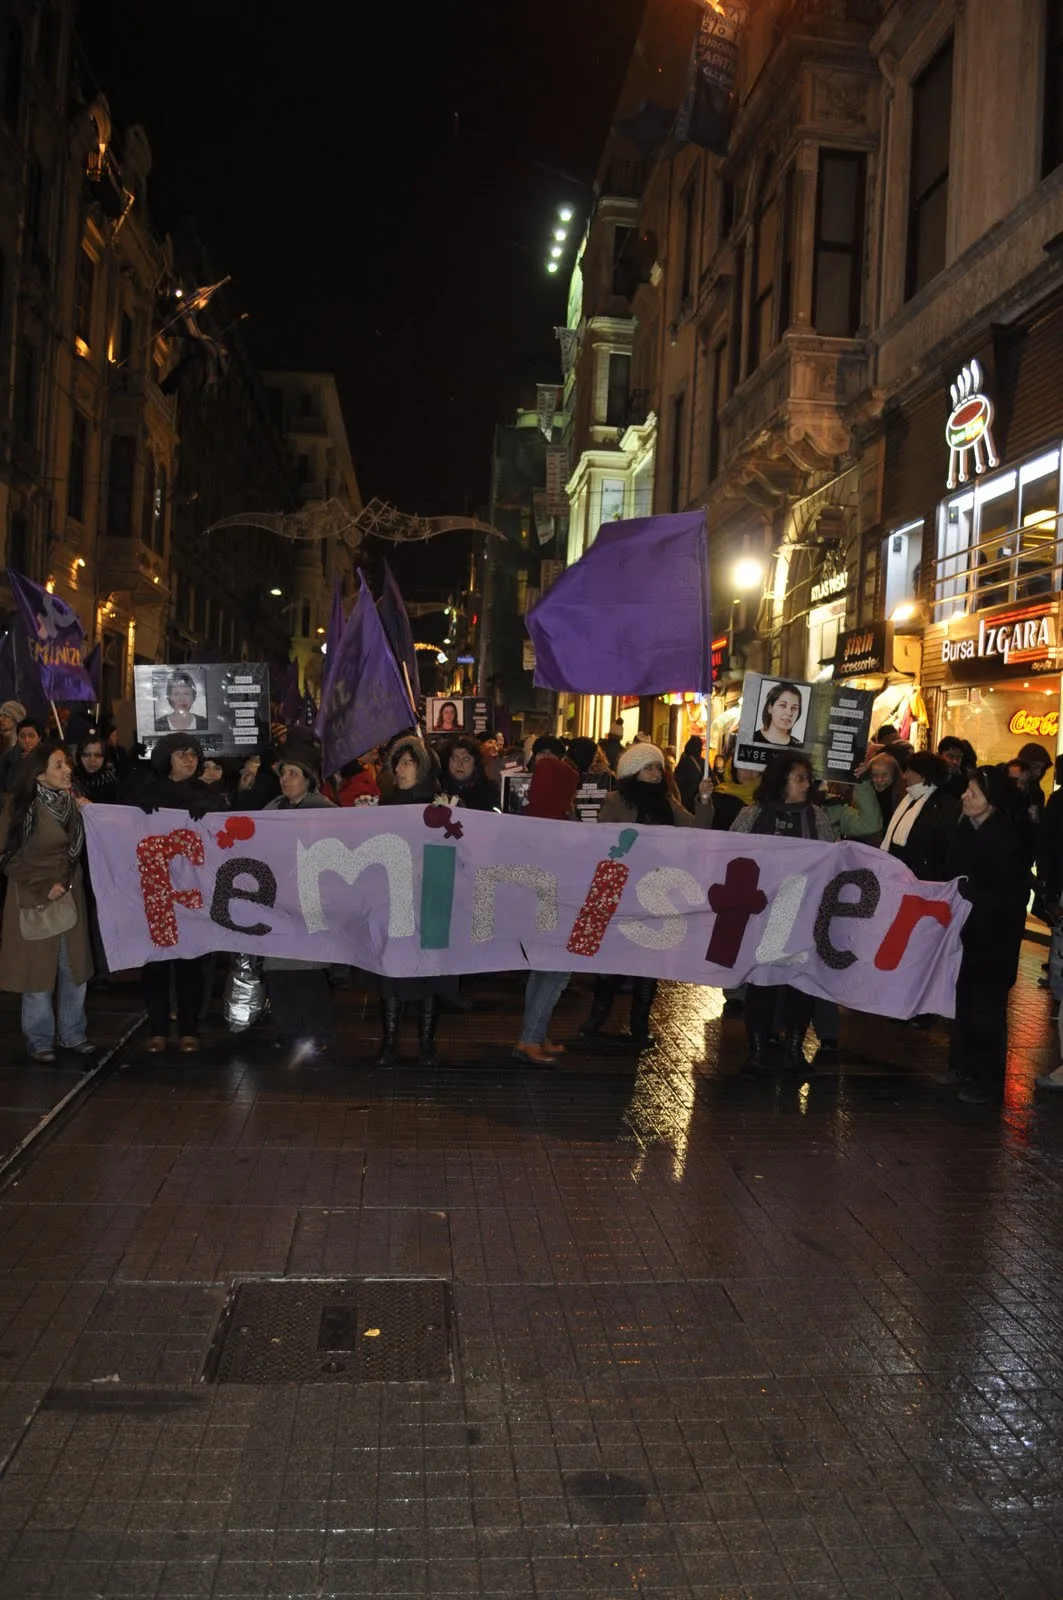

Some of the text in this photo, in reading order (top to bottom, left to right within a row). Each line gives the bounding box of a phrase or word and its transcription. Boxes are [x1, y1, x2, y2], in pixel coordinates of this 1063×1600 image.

[942, 639, 974, 662] Bursa
[738, 749, 767, 761] AYŞE
[136, 806, 954, 972] Feministler
